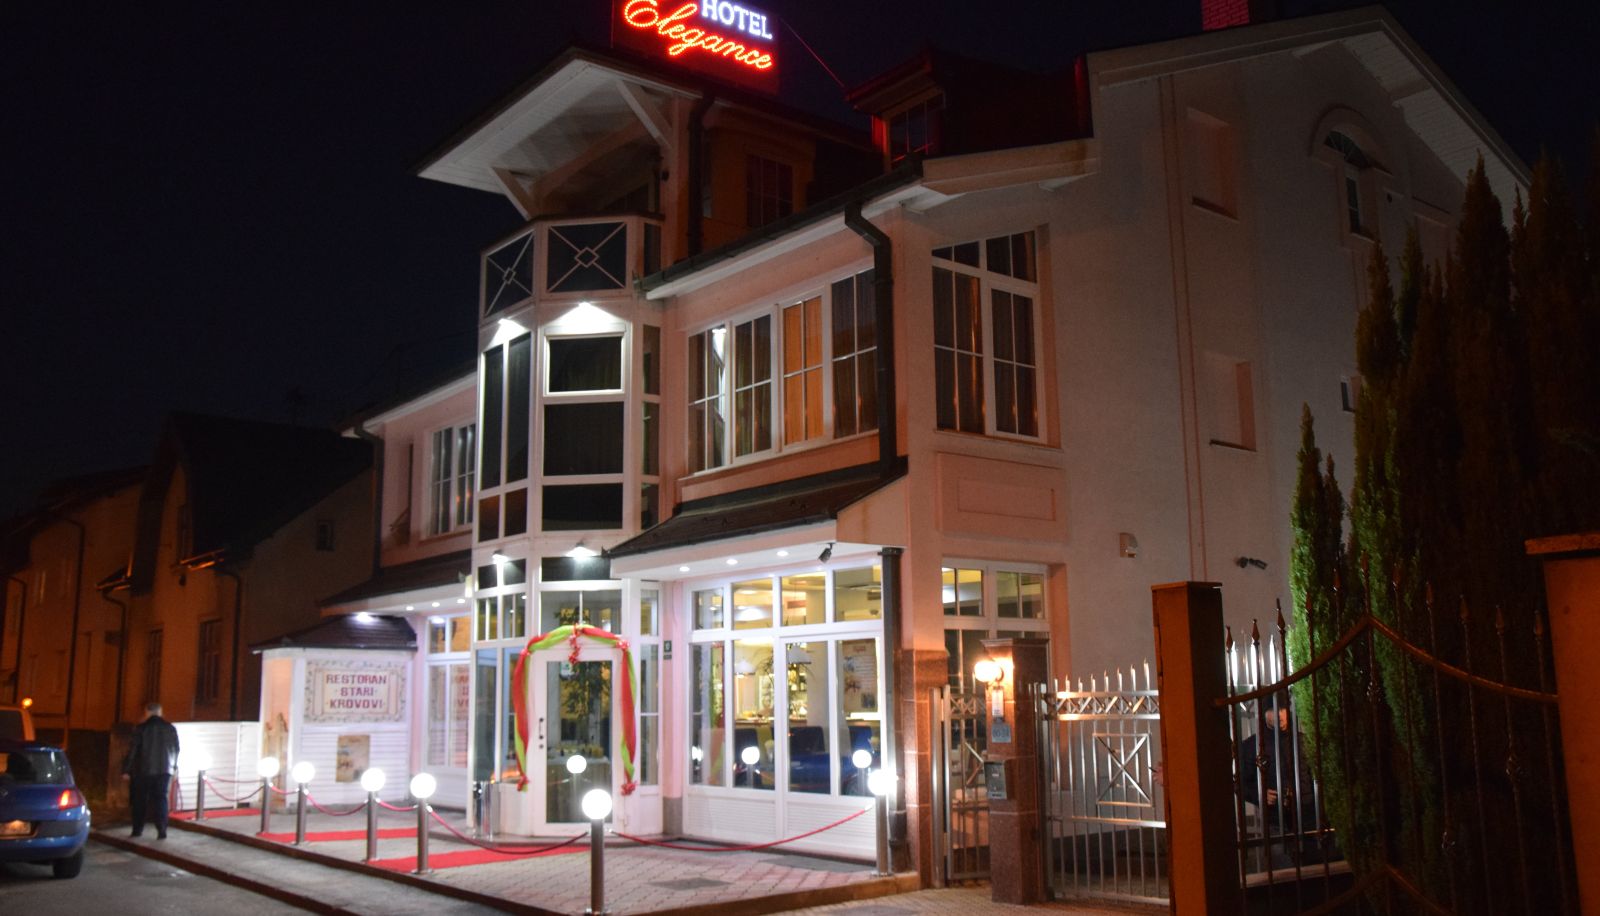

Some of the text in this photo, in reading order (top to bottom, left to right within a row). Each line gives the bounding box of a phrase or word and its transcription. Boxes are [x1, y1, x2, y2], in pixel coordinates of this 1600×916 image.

[624, 0, 772, 69] Elegance
[701, 0, 773, 40] HOTEL
[325, 674, 387, 685] RESTORAN
